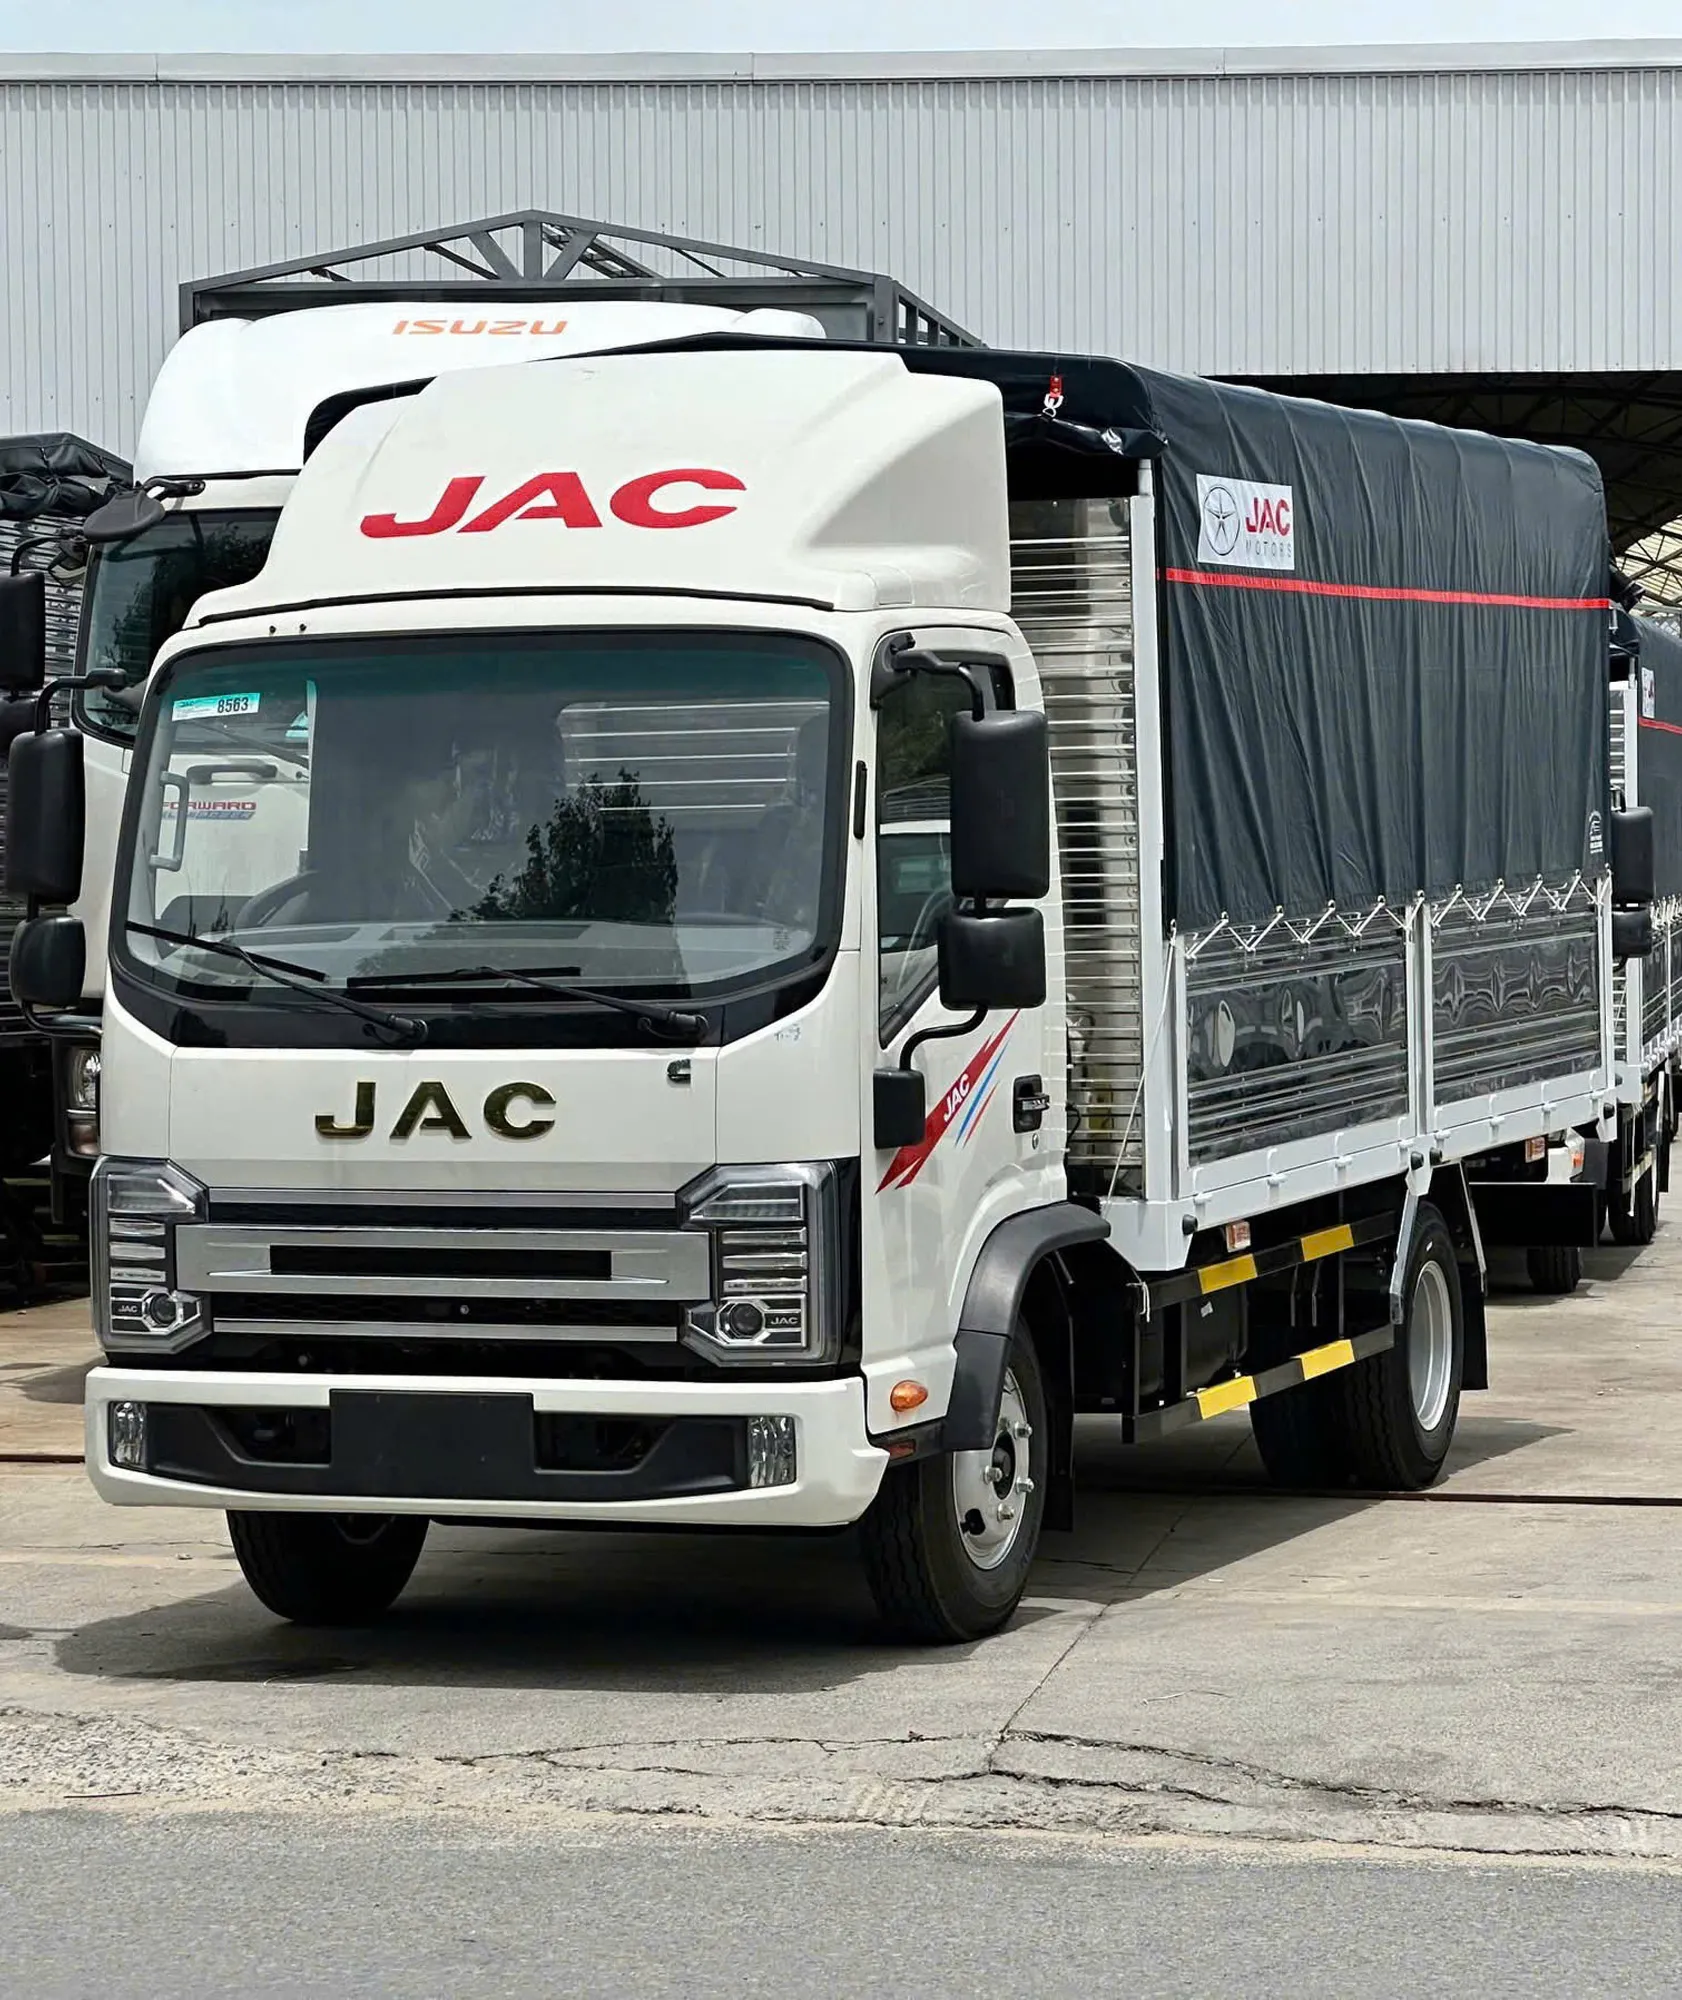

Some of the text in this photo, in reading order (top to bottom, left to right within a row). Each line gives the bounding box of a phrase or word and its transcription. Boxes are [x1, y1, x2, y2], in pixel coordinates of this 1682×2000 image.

[392, 319, 568, 335] ISUZU
[360, 468, 747, 539] JAC
[1245, 497, 1291, 537] JAC
[217, 697, 249, 714] 8563
[315, 1081, 557, 1140] JAC
[943, 1073, 970, 1122] JAC
[118, 1305, 138, 1313] JAC
[770, 1317, 799, 1325] JAC
